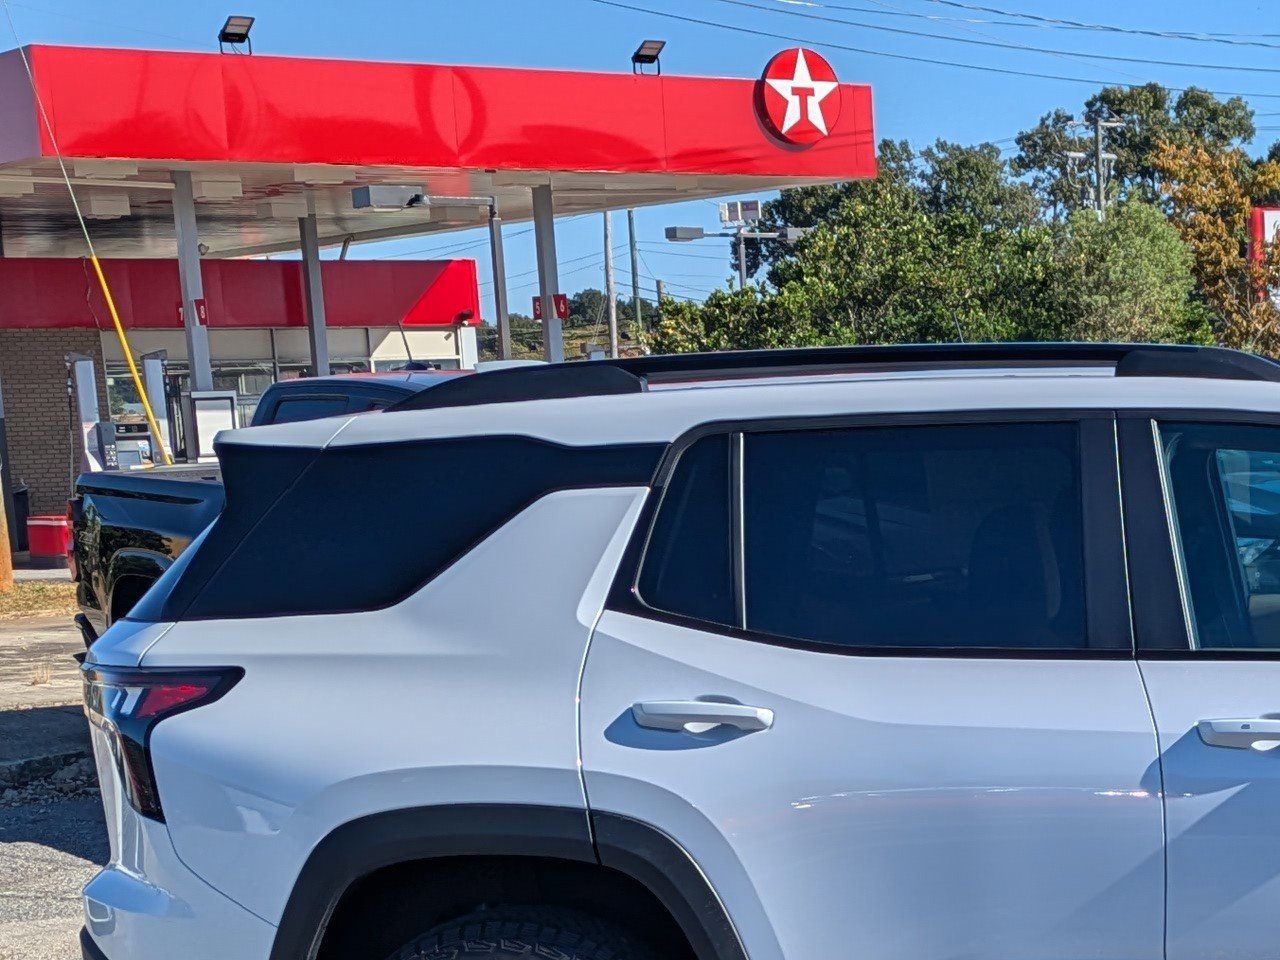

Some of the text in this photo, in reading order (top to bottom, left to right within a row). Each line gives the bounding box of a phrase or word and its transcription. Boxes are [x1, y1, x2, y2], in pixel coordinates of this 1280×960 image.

[791, 87, 815, 123] T
[535, 302, 540, 315] 5
[560, 300, 565, 313] 6
